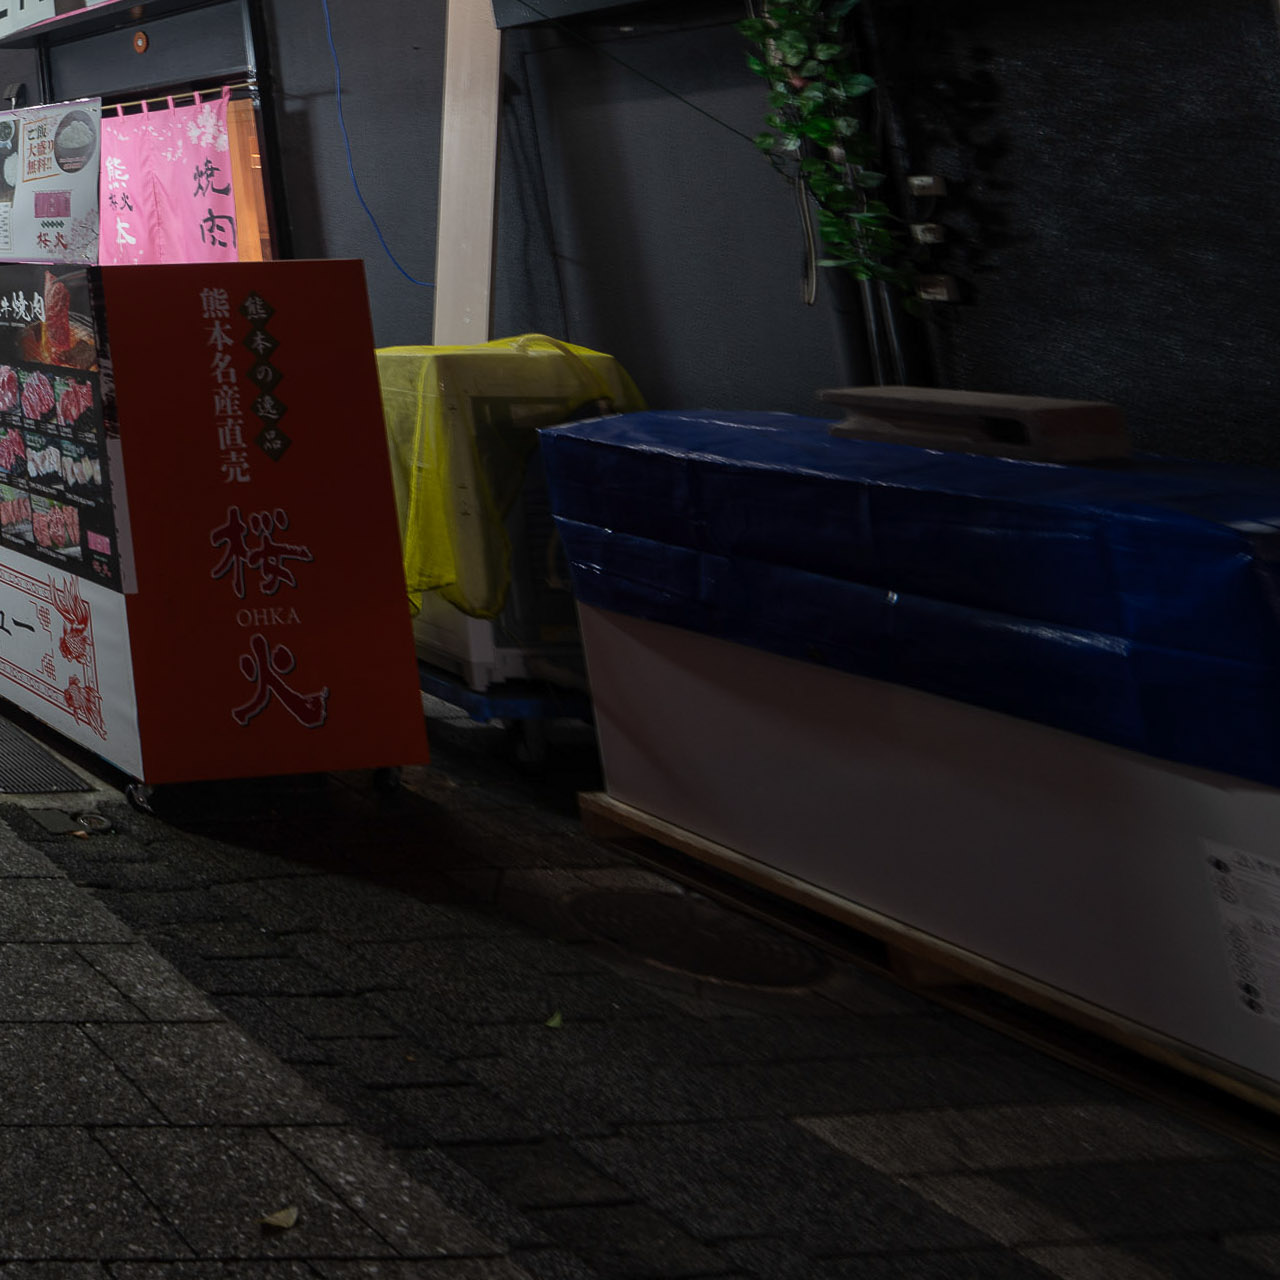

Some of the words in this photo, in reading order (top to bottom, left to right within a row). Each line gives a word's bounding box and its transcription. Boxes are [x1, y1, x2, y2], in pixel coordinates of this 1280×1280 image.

[37, 231, 68, 249] 桜火
[193, 157, 237, 249] 焼肉
[199, 287, 252, 484] 熊本名産直売
[244, 295, 282, 451] 熊本の逸品
[208, 505, 330, 728] 桜火
[236, 607, 303, 628] OHKA
